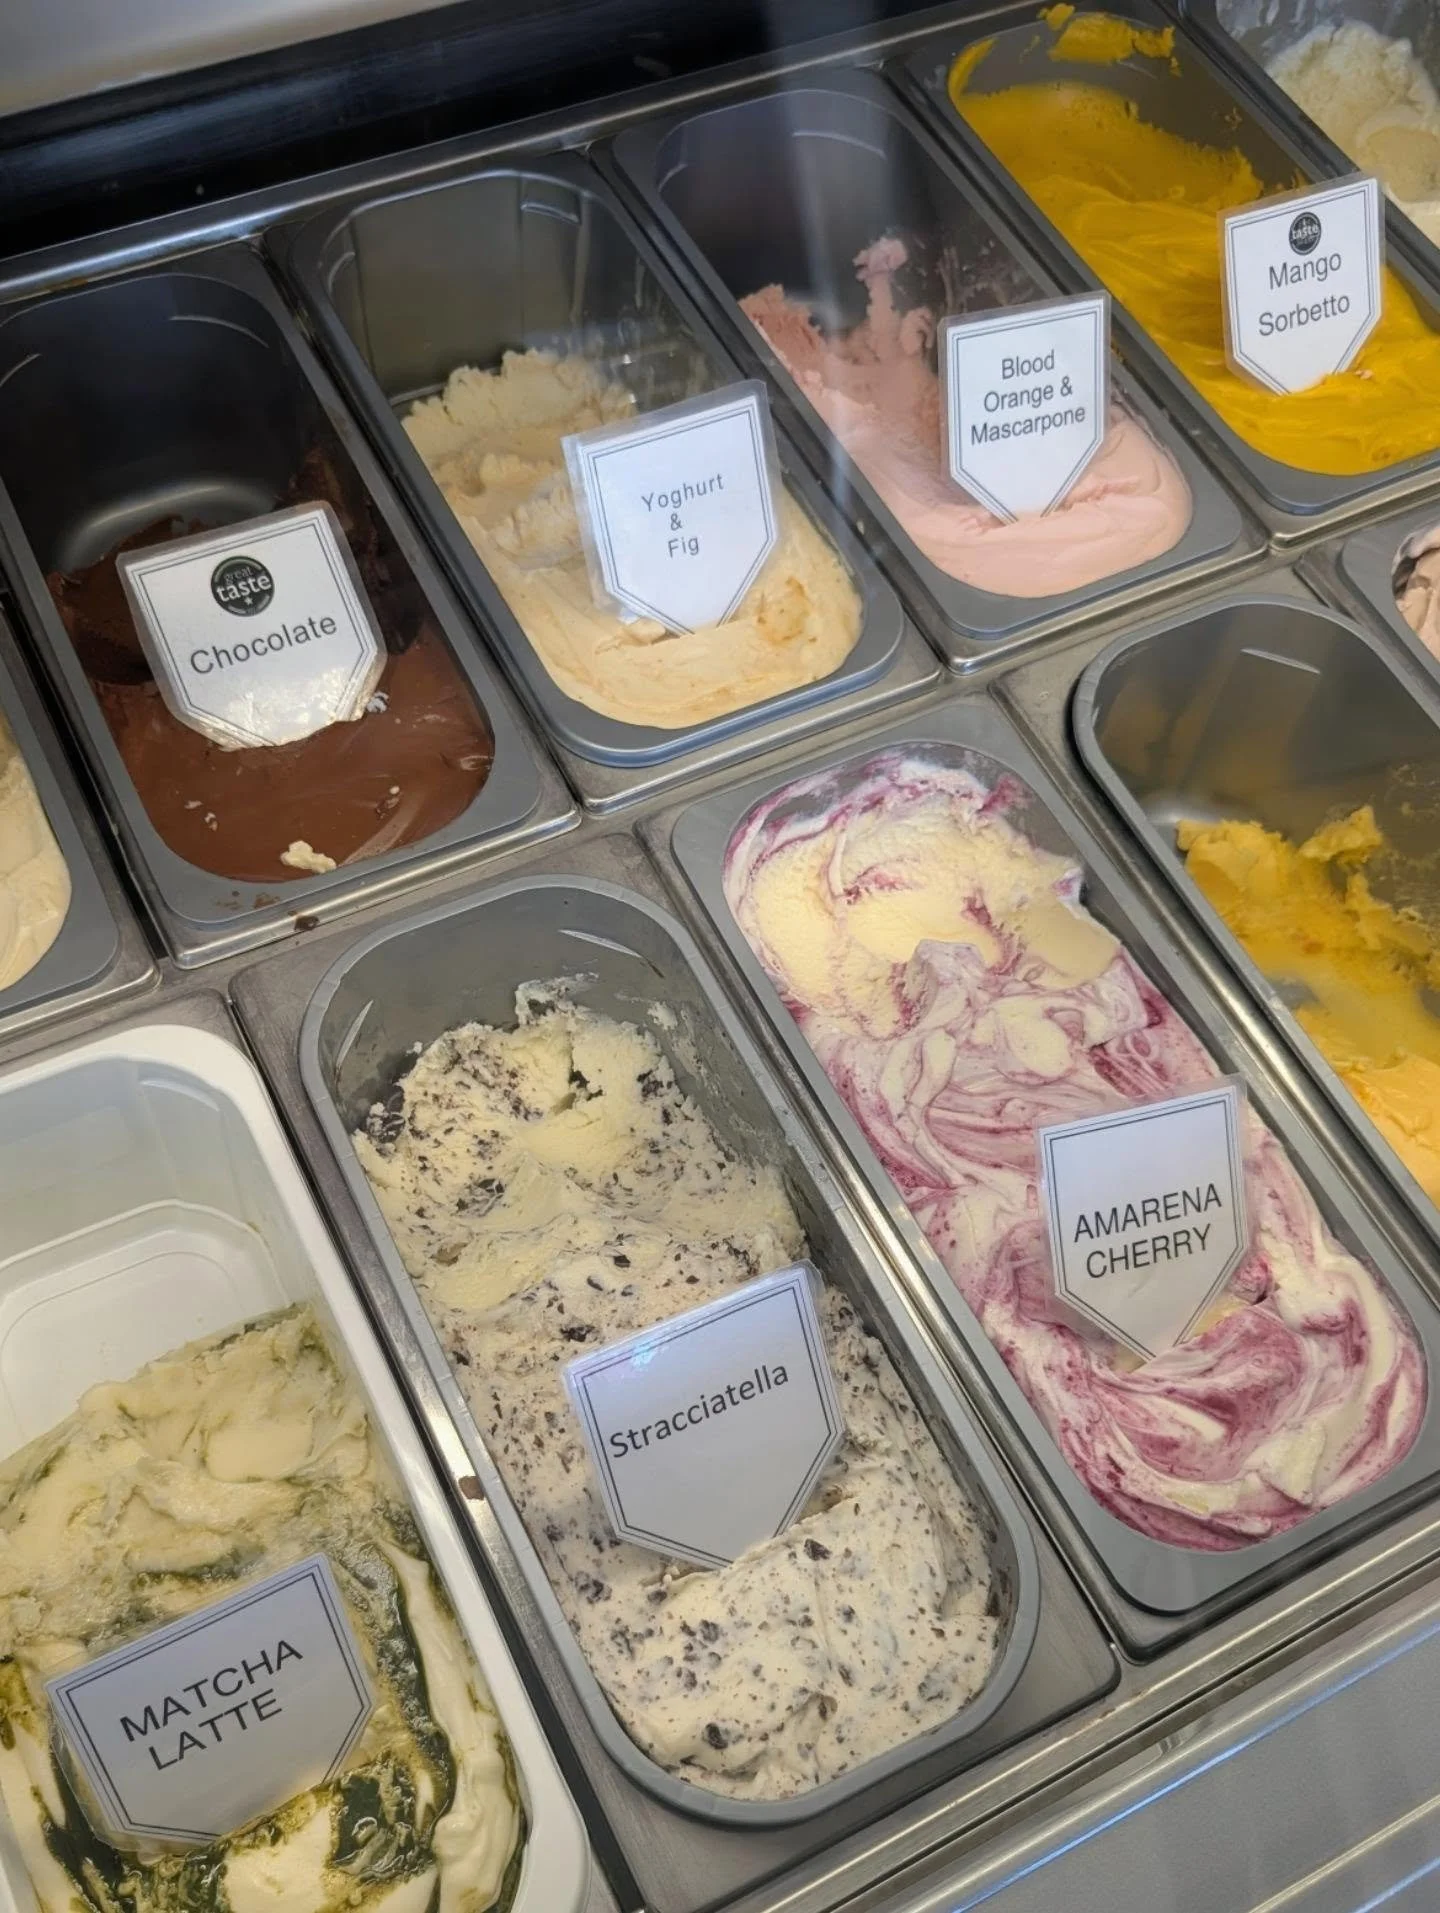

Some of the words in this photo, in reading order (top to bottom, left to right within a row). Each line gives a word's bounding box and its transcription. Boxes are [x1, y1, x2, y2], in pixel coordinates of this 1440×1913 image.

[1268, 253, 1342, 290] Mango
[1258, 295, 1350, 336] Sorbetto
[1001, 349, 1055, 380] Blood
[983, 383, 1054, 413] Orange
[1060, 375, 1073, 397] &
[970, 406, 1086, 446] Mascarpone
[641, 473, 724, 512] Yoghurt
[670, 512, 683, 531] &
[667, 536, 699, 558] Fig
[216, 575, 272, 602] taste
[190, 616, 338, 675] Chocolate
[1073, 1183, 1222, 1243] AMARENA
[1085, 1223, 1211, 1279] CHERRY
[609, 1365, 789, 1458] Stracciatella
[119, 1640, 304, 1742] MATCHA
[148, 1688, 283, 1771] LATTE
